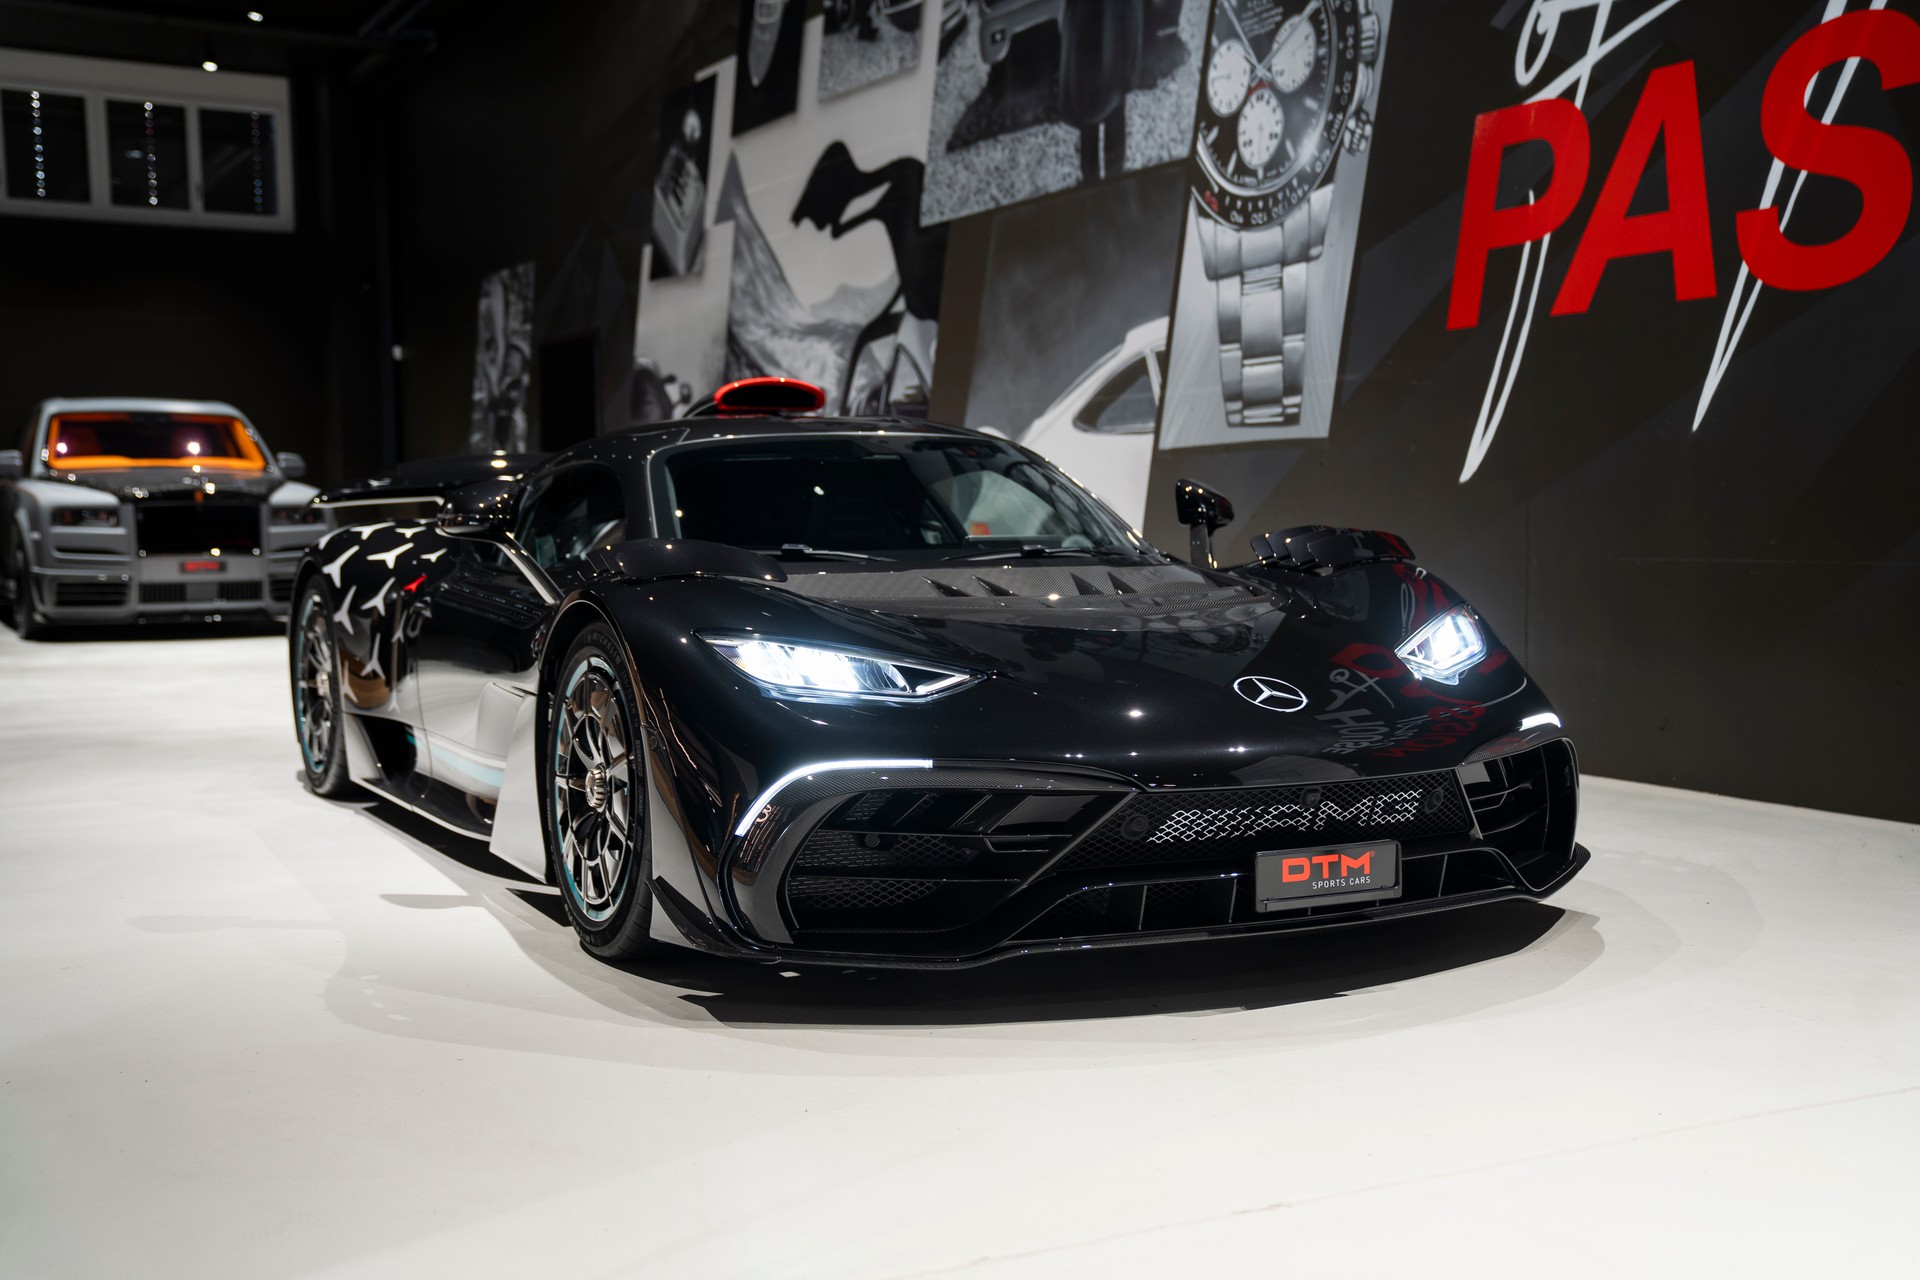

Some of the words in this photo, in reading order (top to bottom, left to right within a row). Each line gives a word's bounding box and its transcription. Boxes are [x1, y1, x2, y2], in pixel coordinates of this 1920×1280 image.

[1238, 789, 1423, 839] AMG
[1281, 851, 1372, 883] DTM
[1312, 878, 1346, 890] SPORTS
[1349, 875, 1372, 887] CARS
